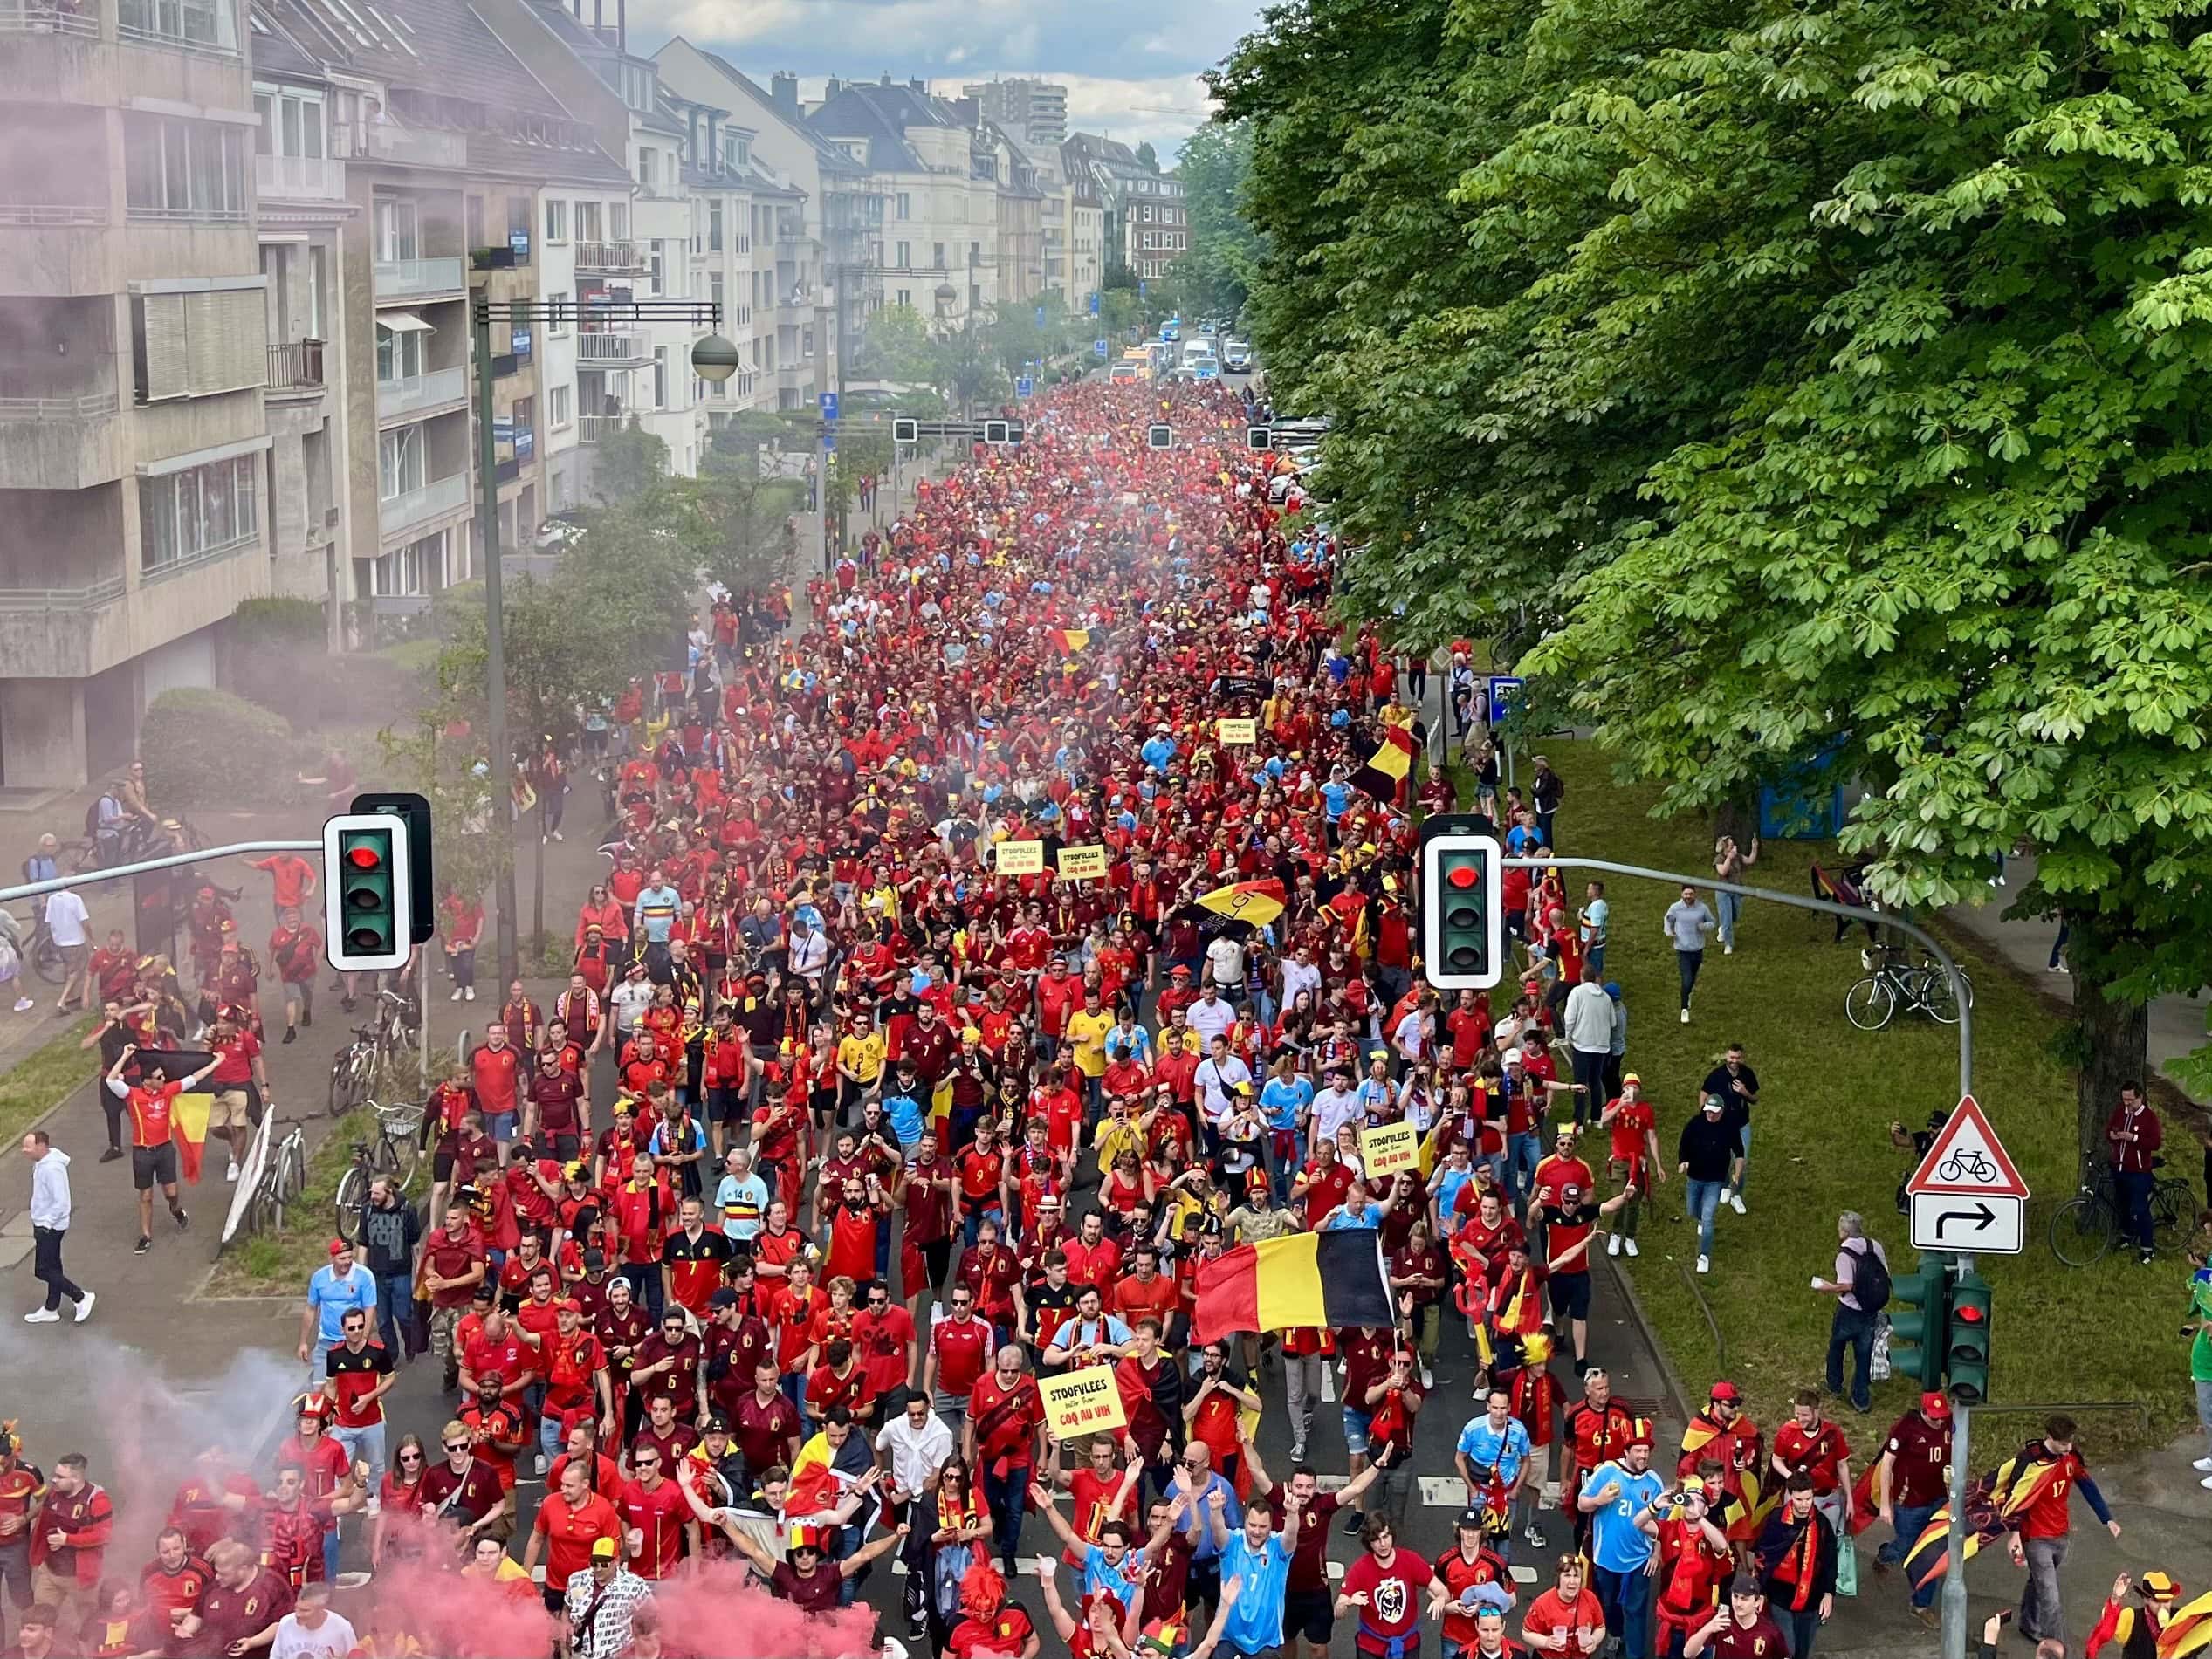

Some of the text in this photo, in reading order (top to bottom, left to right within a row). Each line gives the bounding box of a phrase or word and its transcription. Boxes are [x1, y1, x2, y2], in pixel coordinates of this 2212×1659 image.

[924, 1045, 930, 1057] 7
[1369, 1130, 1411, 1148] STOOFVLEES
[733, 1190, 743, 1199] 14
[689, 1261, 697, 1276] 7
[1052, 1309, 1060, 1325] 7
[730, 1351, 738, 1365] 6
[668, 1374, 677, 1389] 6
[1050, 1379, 1108, 1402] STOOFVLEES
[1060, 1403, 1112, 1426] COQ AU VIN
[1210, 1401, 1219, 1416] 7
[1928, 1446, 1942, 1463] 10
[2052, 1480, 2065, 1498] 17
[1618, 1499, 1632, 1516] 21
[1249, 1573, 1258, 1592] 7
